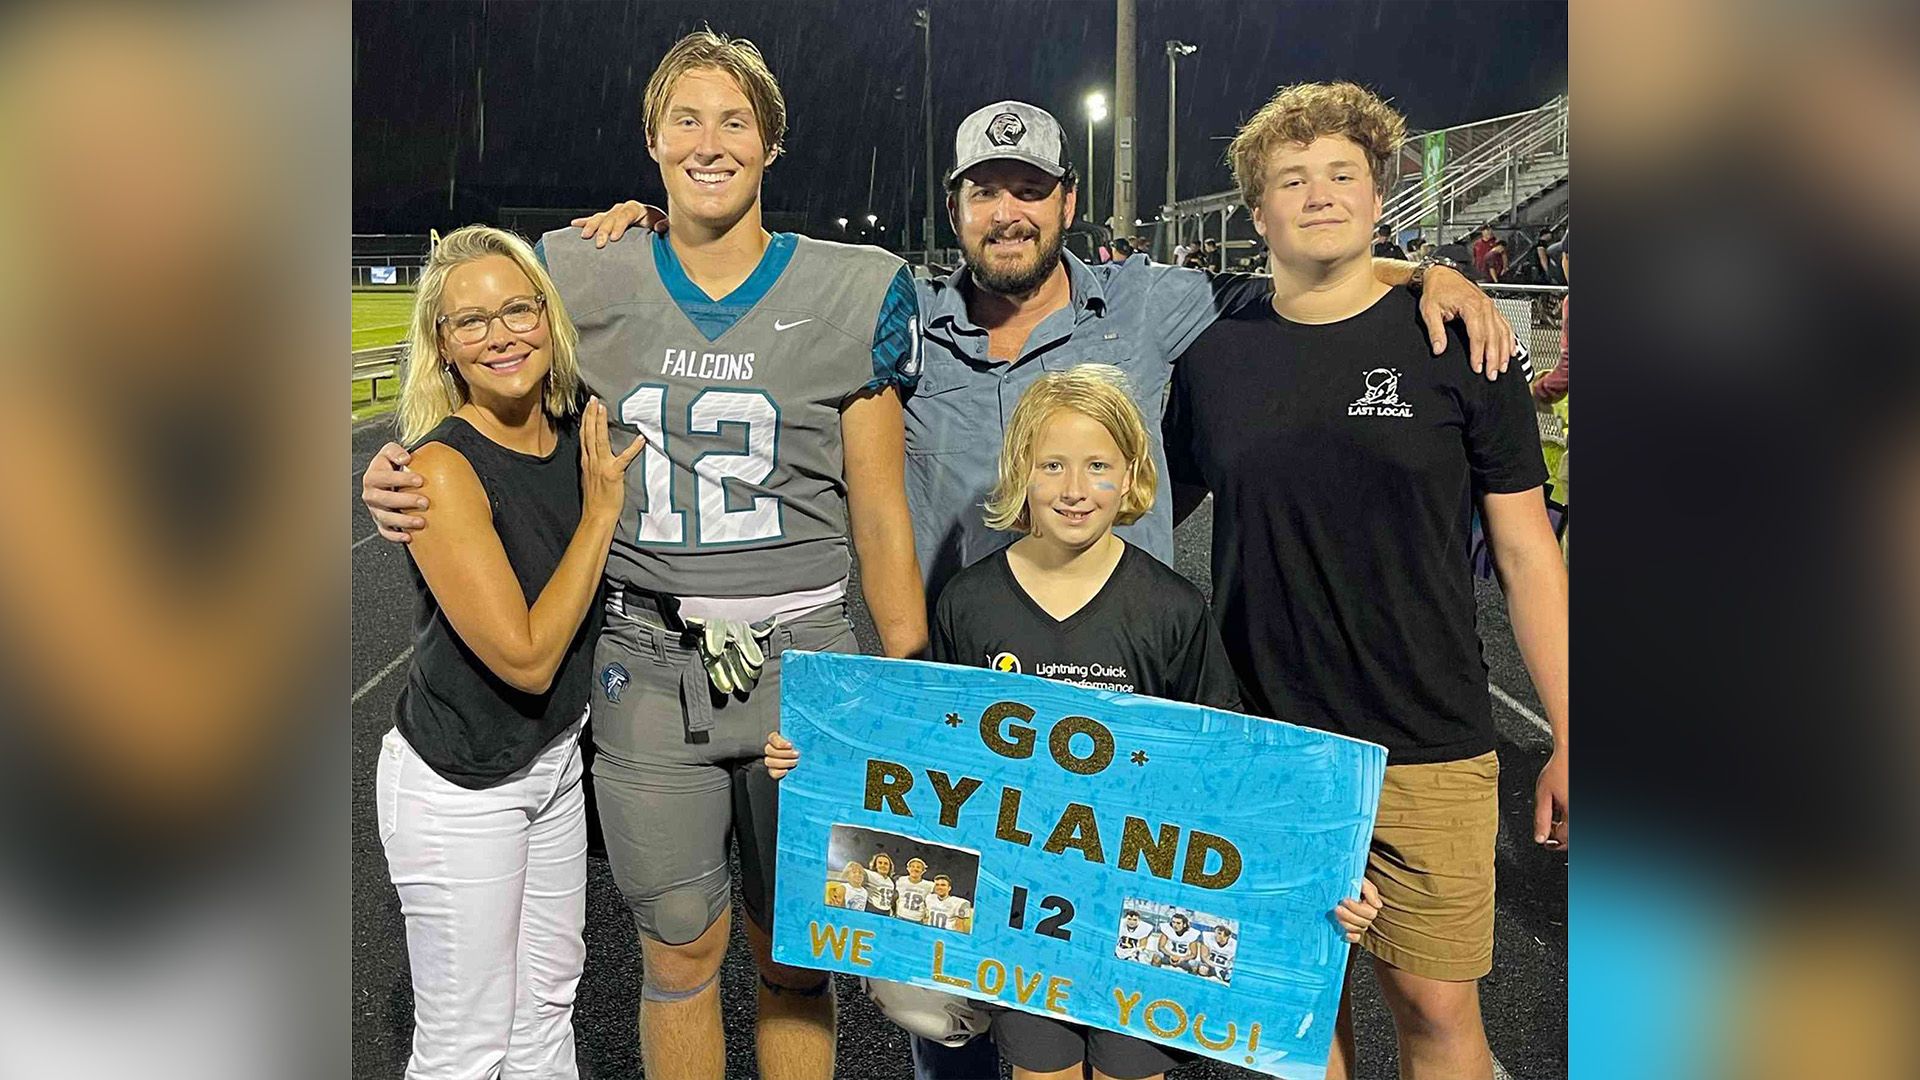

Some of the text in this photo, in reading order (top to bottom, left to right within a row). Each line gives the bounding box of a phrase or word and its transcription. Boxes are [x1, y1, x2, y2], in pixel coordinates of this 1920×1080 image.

[661, 349, 755, 380] FALCONS
[1347, 406, 1414, 418] LAST LOCAL
[618, 384, 784, 547] 12
[1036, 663, 1127, 678] Lightning Quick
[979, 701, 1115, 775] GO
[863, 759, 1242, 889] RYLAND
[1008, 886, 1075, 941] 12
[1171, 941, 1188, 954] 15
[810, 922, 1261, 1065] WE LOVE YOU!
